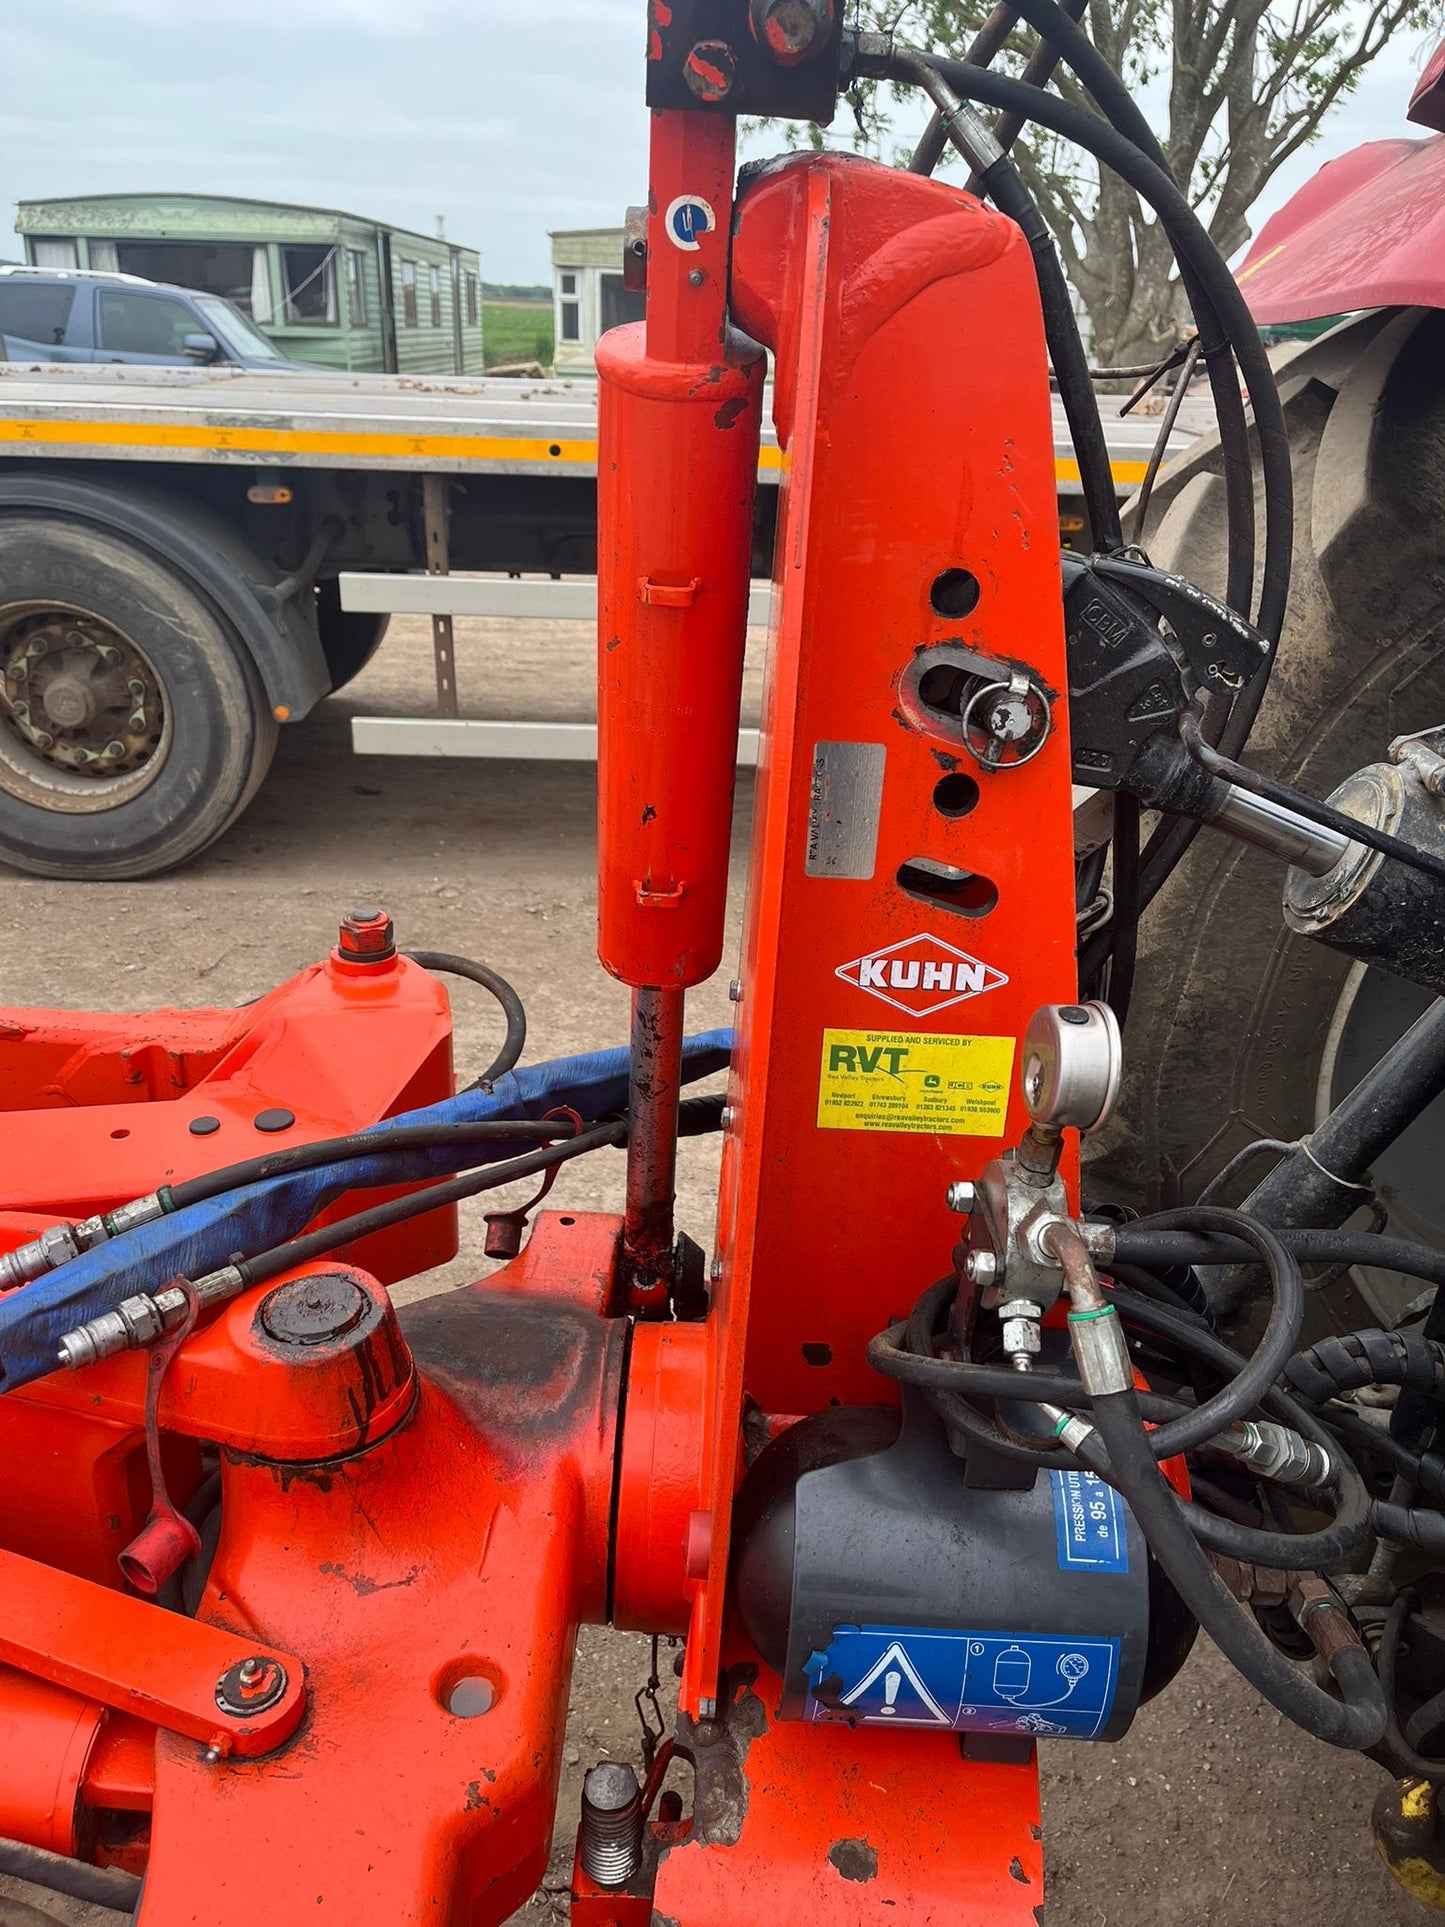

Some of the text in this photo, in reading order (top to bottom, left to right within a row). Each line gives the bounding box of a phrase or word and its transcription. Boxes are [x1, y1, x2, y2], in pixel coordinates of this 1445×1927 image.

[859, 958, 986, 992] KUHN
[866, 1034, 904, 1044] SUPPLIED
[905, 1036, 921, 1044] AND
[923, 1037, 961, 1046] SERVICED
[829, 1044, 909, 1075] RVT
[949, 1081, 972, 1090] JCB
[872, 1094, 906, 1102] Shrewsbury
[923, 1096, 948, 1104] Sudbury
[966, 1098, 996, 1106] Welshpool
[855, 1113, 965, 1124] enquiries@reavalleytractors.com
[864, 1121, 953, 1131] www.reavalleytractors.com
[1070, 1490, 1087, 1542] PRESSION
[1089, 1501, 1107, 1520] 95
[1097, 1525, 1108, 1538] de
